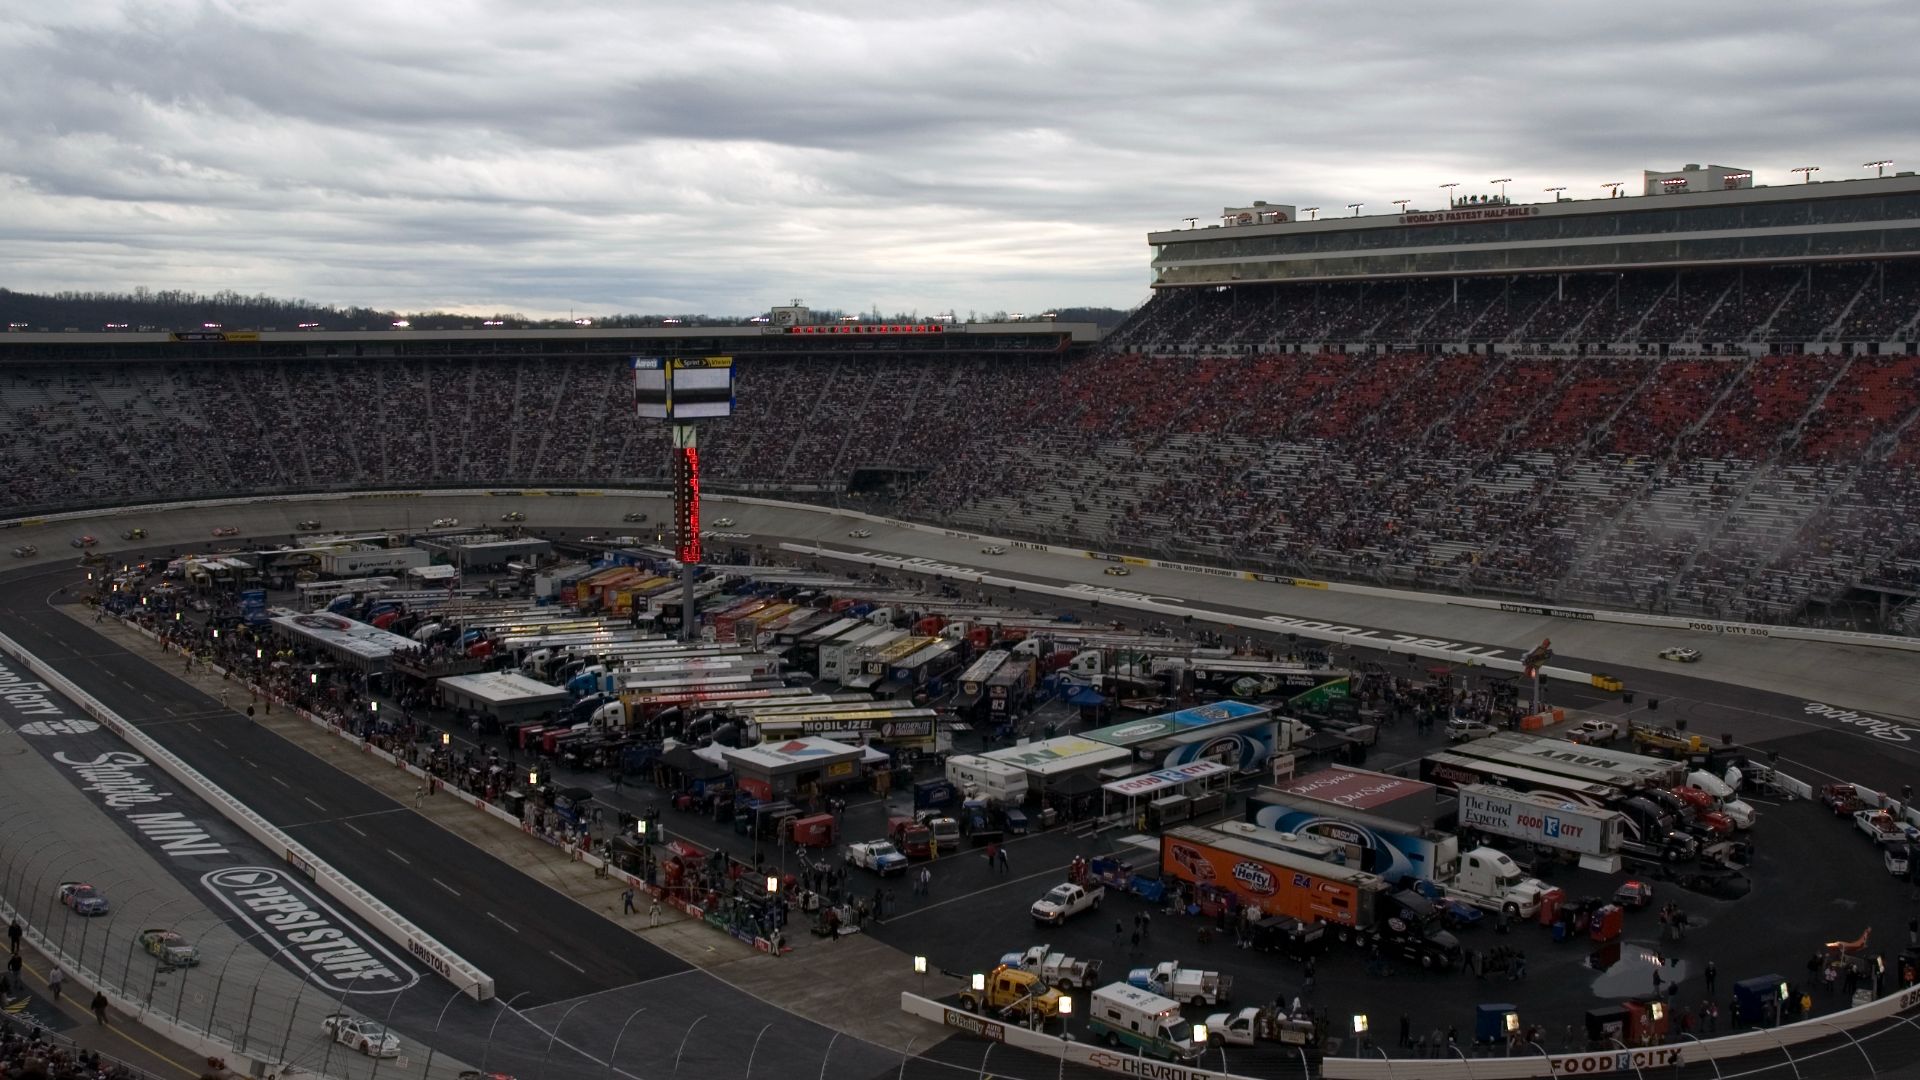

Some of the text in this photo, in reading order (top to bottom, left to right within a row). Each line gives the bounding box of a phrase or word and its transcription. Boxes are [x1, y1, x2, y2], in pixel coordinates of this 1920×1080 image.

[1406, 207, 1530, 224] WORLD'S FASTEST HALF-MILE
[683, 359, 700, 367] Sprint
[1502, 604, 1543, 615] sharpie.com
[1550, 609, 1594, 621] sharpie.com
[1689, 622, 1769, 638] FOOD CITY 500
[867, 662, 884, 673] CAT
[4, 693, 64, 715] CITY
[1534, 750, 1621, 769] NAVY
[53, 751, 173, 807] Sharpie
[1118, 763, 1215, 791] FOOD CITY
[1315, 773, 1356, 788] Spice
[1359, 780, 1402, 797] Spice
[1464, 796, 1512, 816] The Food
[1465, 809, 1509, 828] Experts.
[1517, 815, 1584, 838] FOOD CITY
[126, 812, 230, 856] MINI
[1330, 828, 1360, 843] NASCAR
[1237, 869, 1269, 887] Hefty
[1293, 872, 1312, 889] 24
[236, 886, 390, 981] PEPSI STUFF
[413, 942, 445, 974] BRISTOL
[986, 1023, 1002, 1032] AUTO
[1551, 1049, 1682, 1074] FOOD CITY
